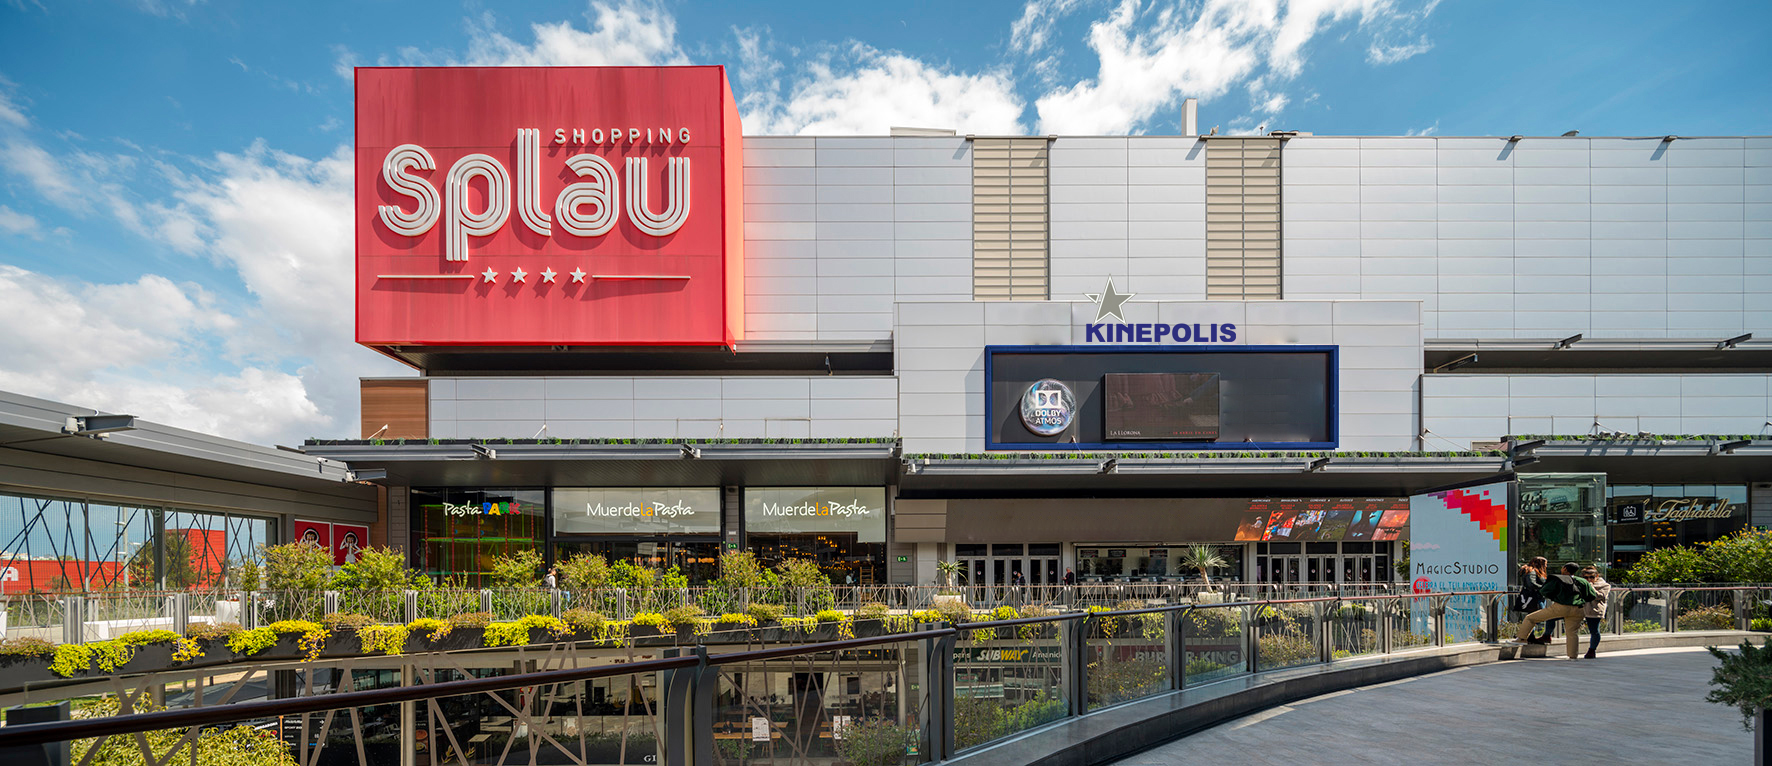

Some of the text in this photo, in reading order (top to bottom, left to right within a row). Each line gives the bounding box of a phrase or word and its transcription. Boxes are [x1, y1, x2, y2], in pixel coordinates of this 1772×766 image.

[554, 128, 691, 145] SHOPPING
[378, 128, 691, 261] Splau
[1085, 323, 1237, 343] KINEPOLIS
[1654, 498, 1732, 522] Tagliatella
[976, 649, 1029, 661] SUBWAY
[1032, 651, 1063, 659] Amanid
[1135, 650, 1239, 664] BURR KING
